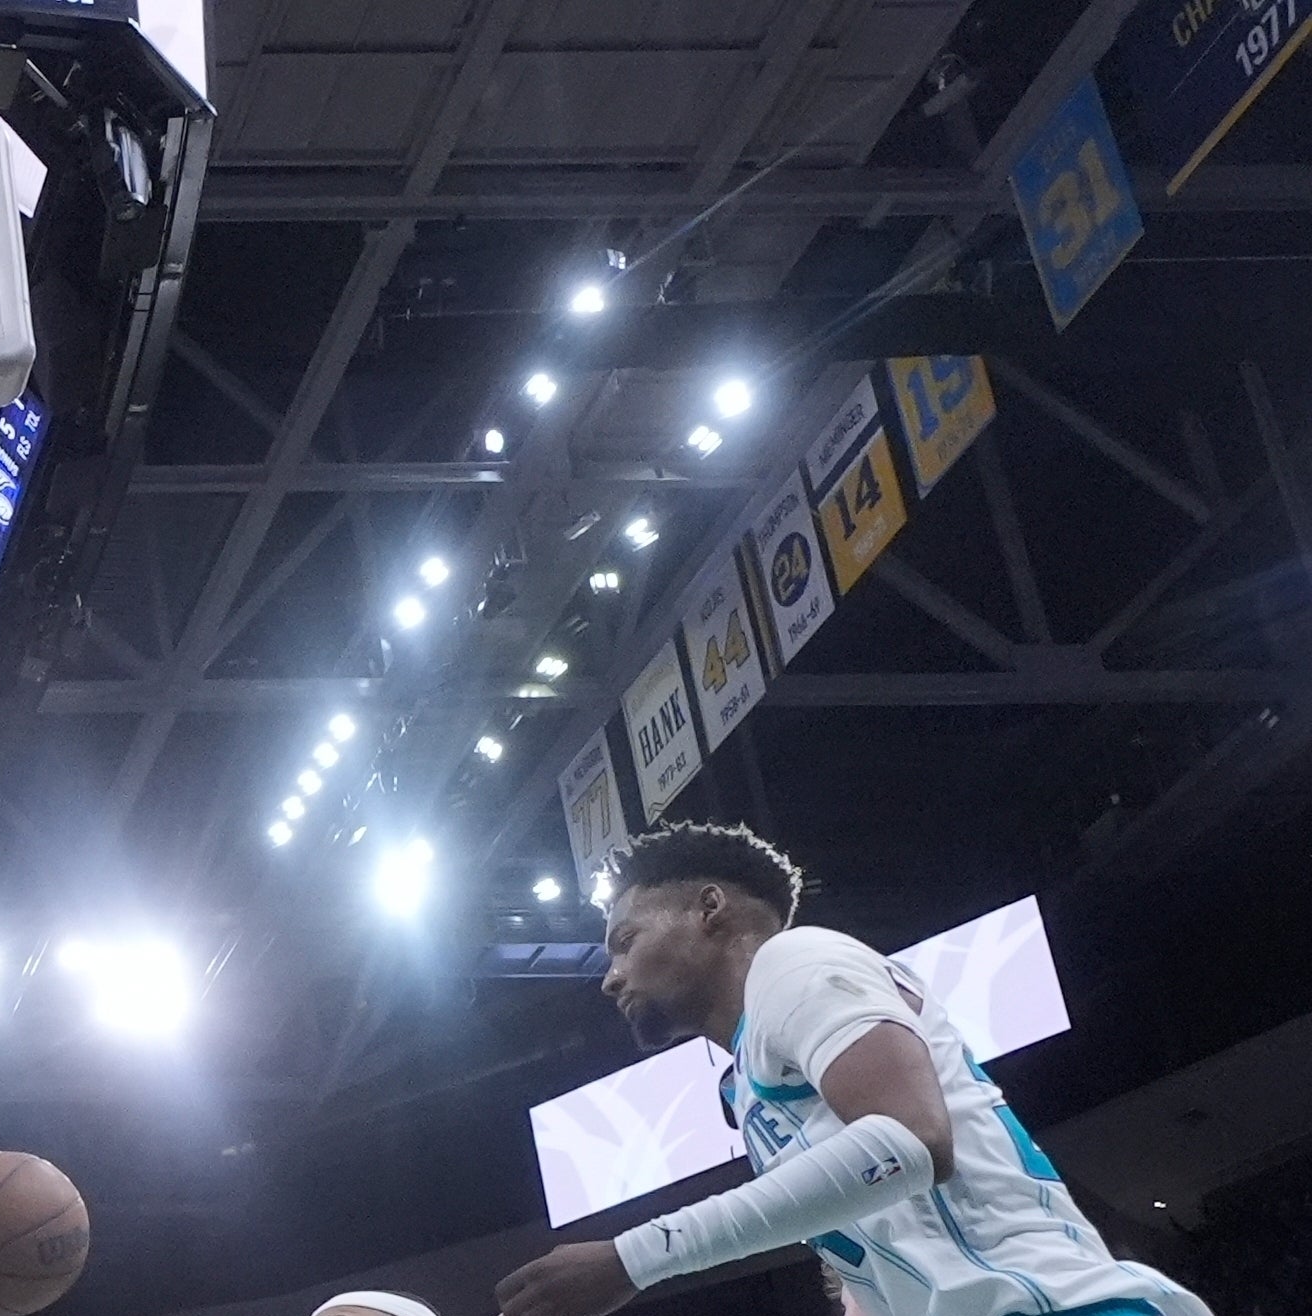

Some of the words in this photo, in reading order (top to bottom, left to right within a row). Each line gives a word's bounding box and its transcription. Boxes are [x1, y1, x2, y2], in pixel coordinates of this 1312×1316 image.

[1040, 137, 1121, 270] 31
[906, 356, 972, 442] 15
[833, 453, 883, 541] 14
[702, 608, 750, 694] 44
[638, 688, 687, 768] HANK
